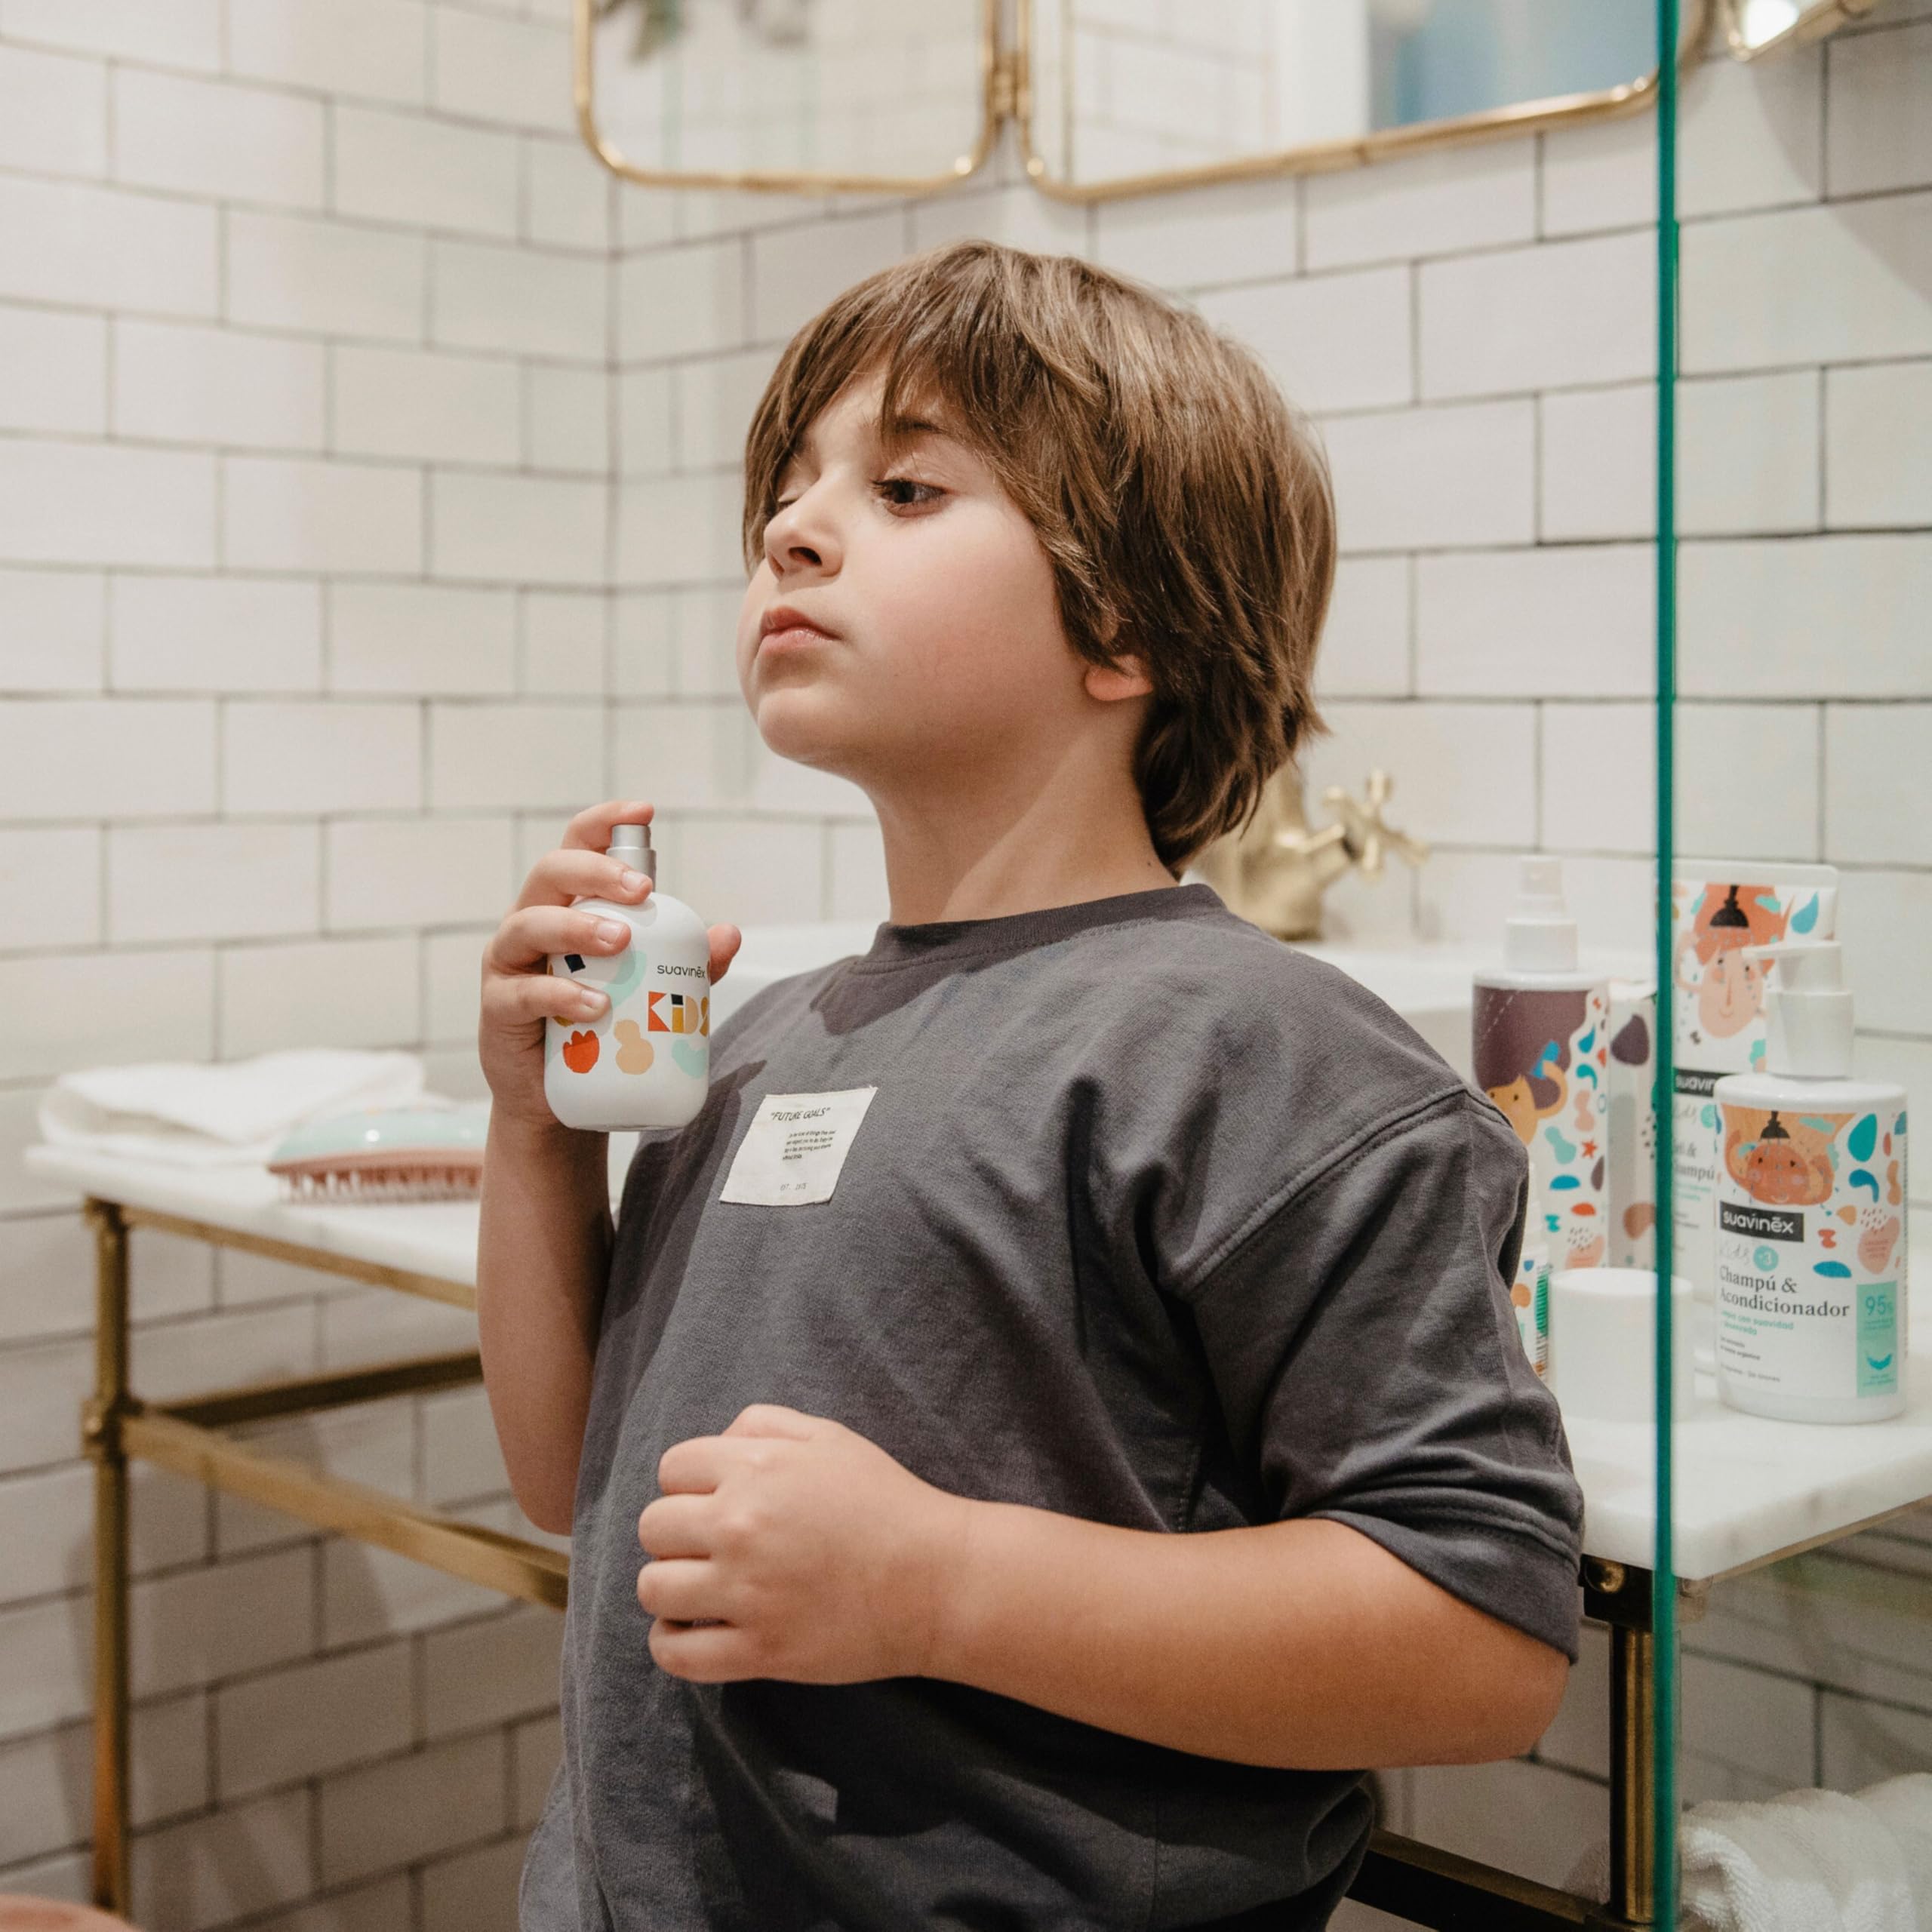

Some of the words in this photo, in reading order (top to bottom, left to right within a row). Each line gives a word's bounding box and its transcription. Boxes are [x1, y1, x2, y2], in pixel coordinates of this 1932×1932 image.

[1720, 1265, 1777, 1293] Champú
[1781, 1276, 1798, 1294] &
[1720, 1287, 1850, 1317] Acondicionador
